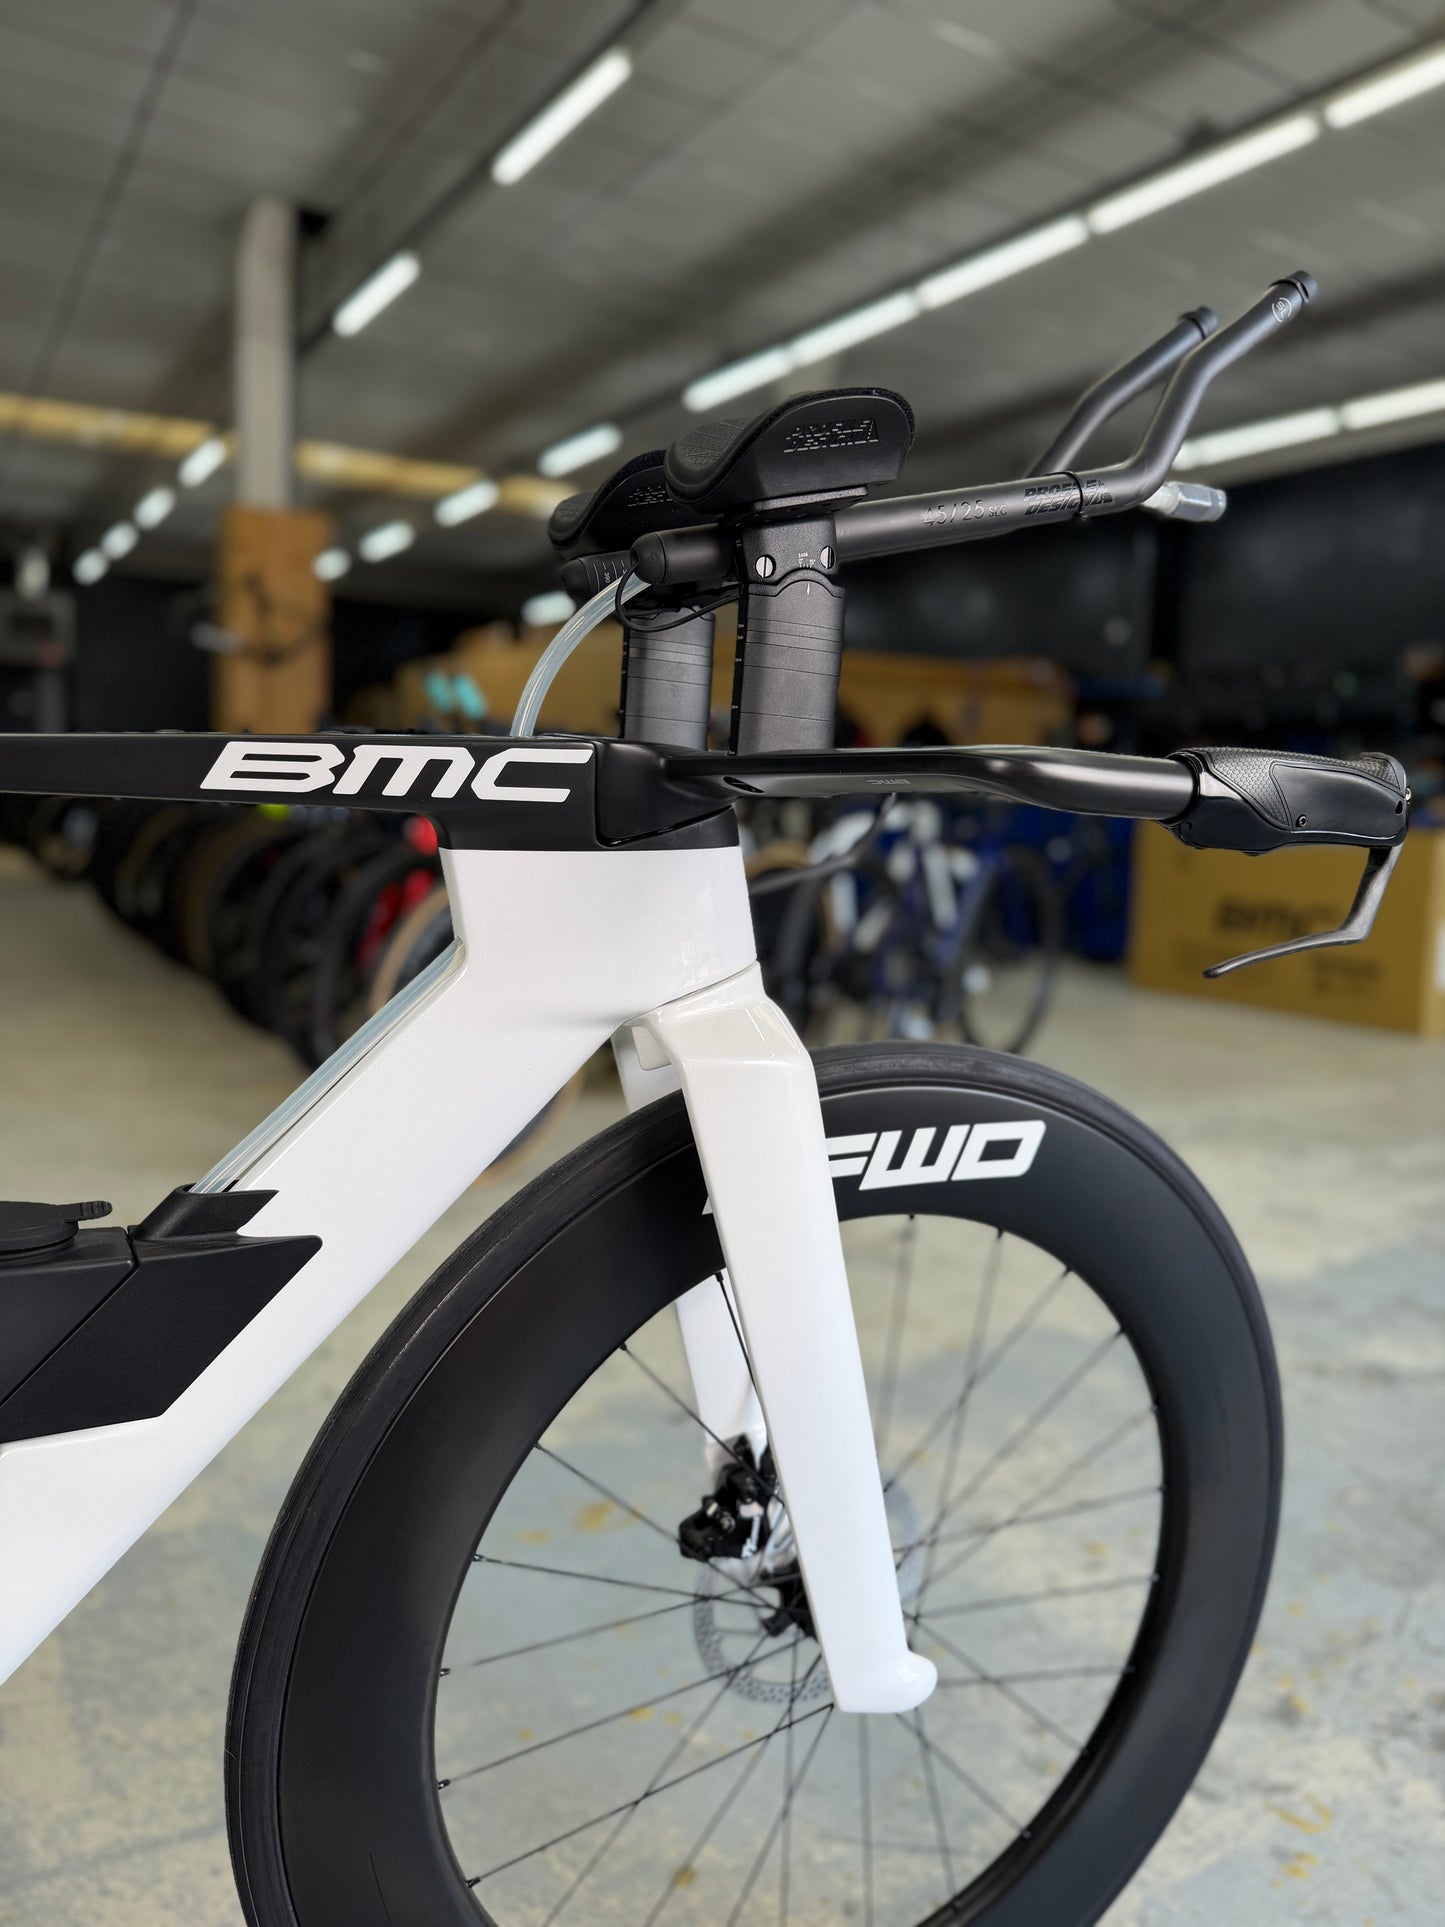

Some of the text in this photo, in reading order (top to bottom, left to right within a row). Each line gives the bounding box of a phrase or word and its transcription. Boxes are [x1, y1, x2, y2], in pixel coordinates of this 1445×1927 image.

[922, 499, 1008, 526] 45/25 SLC
[199, 741, 594, 803] BMC
